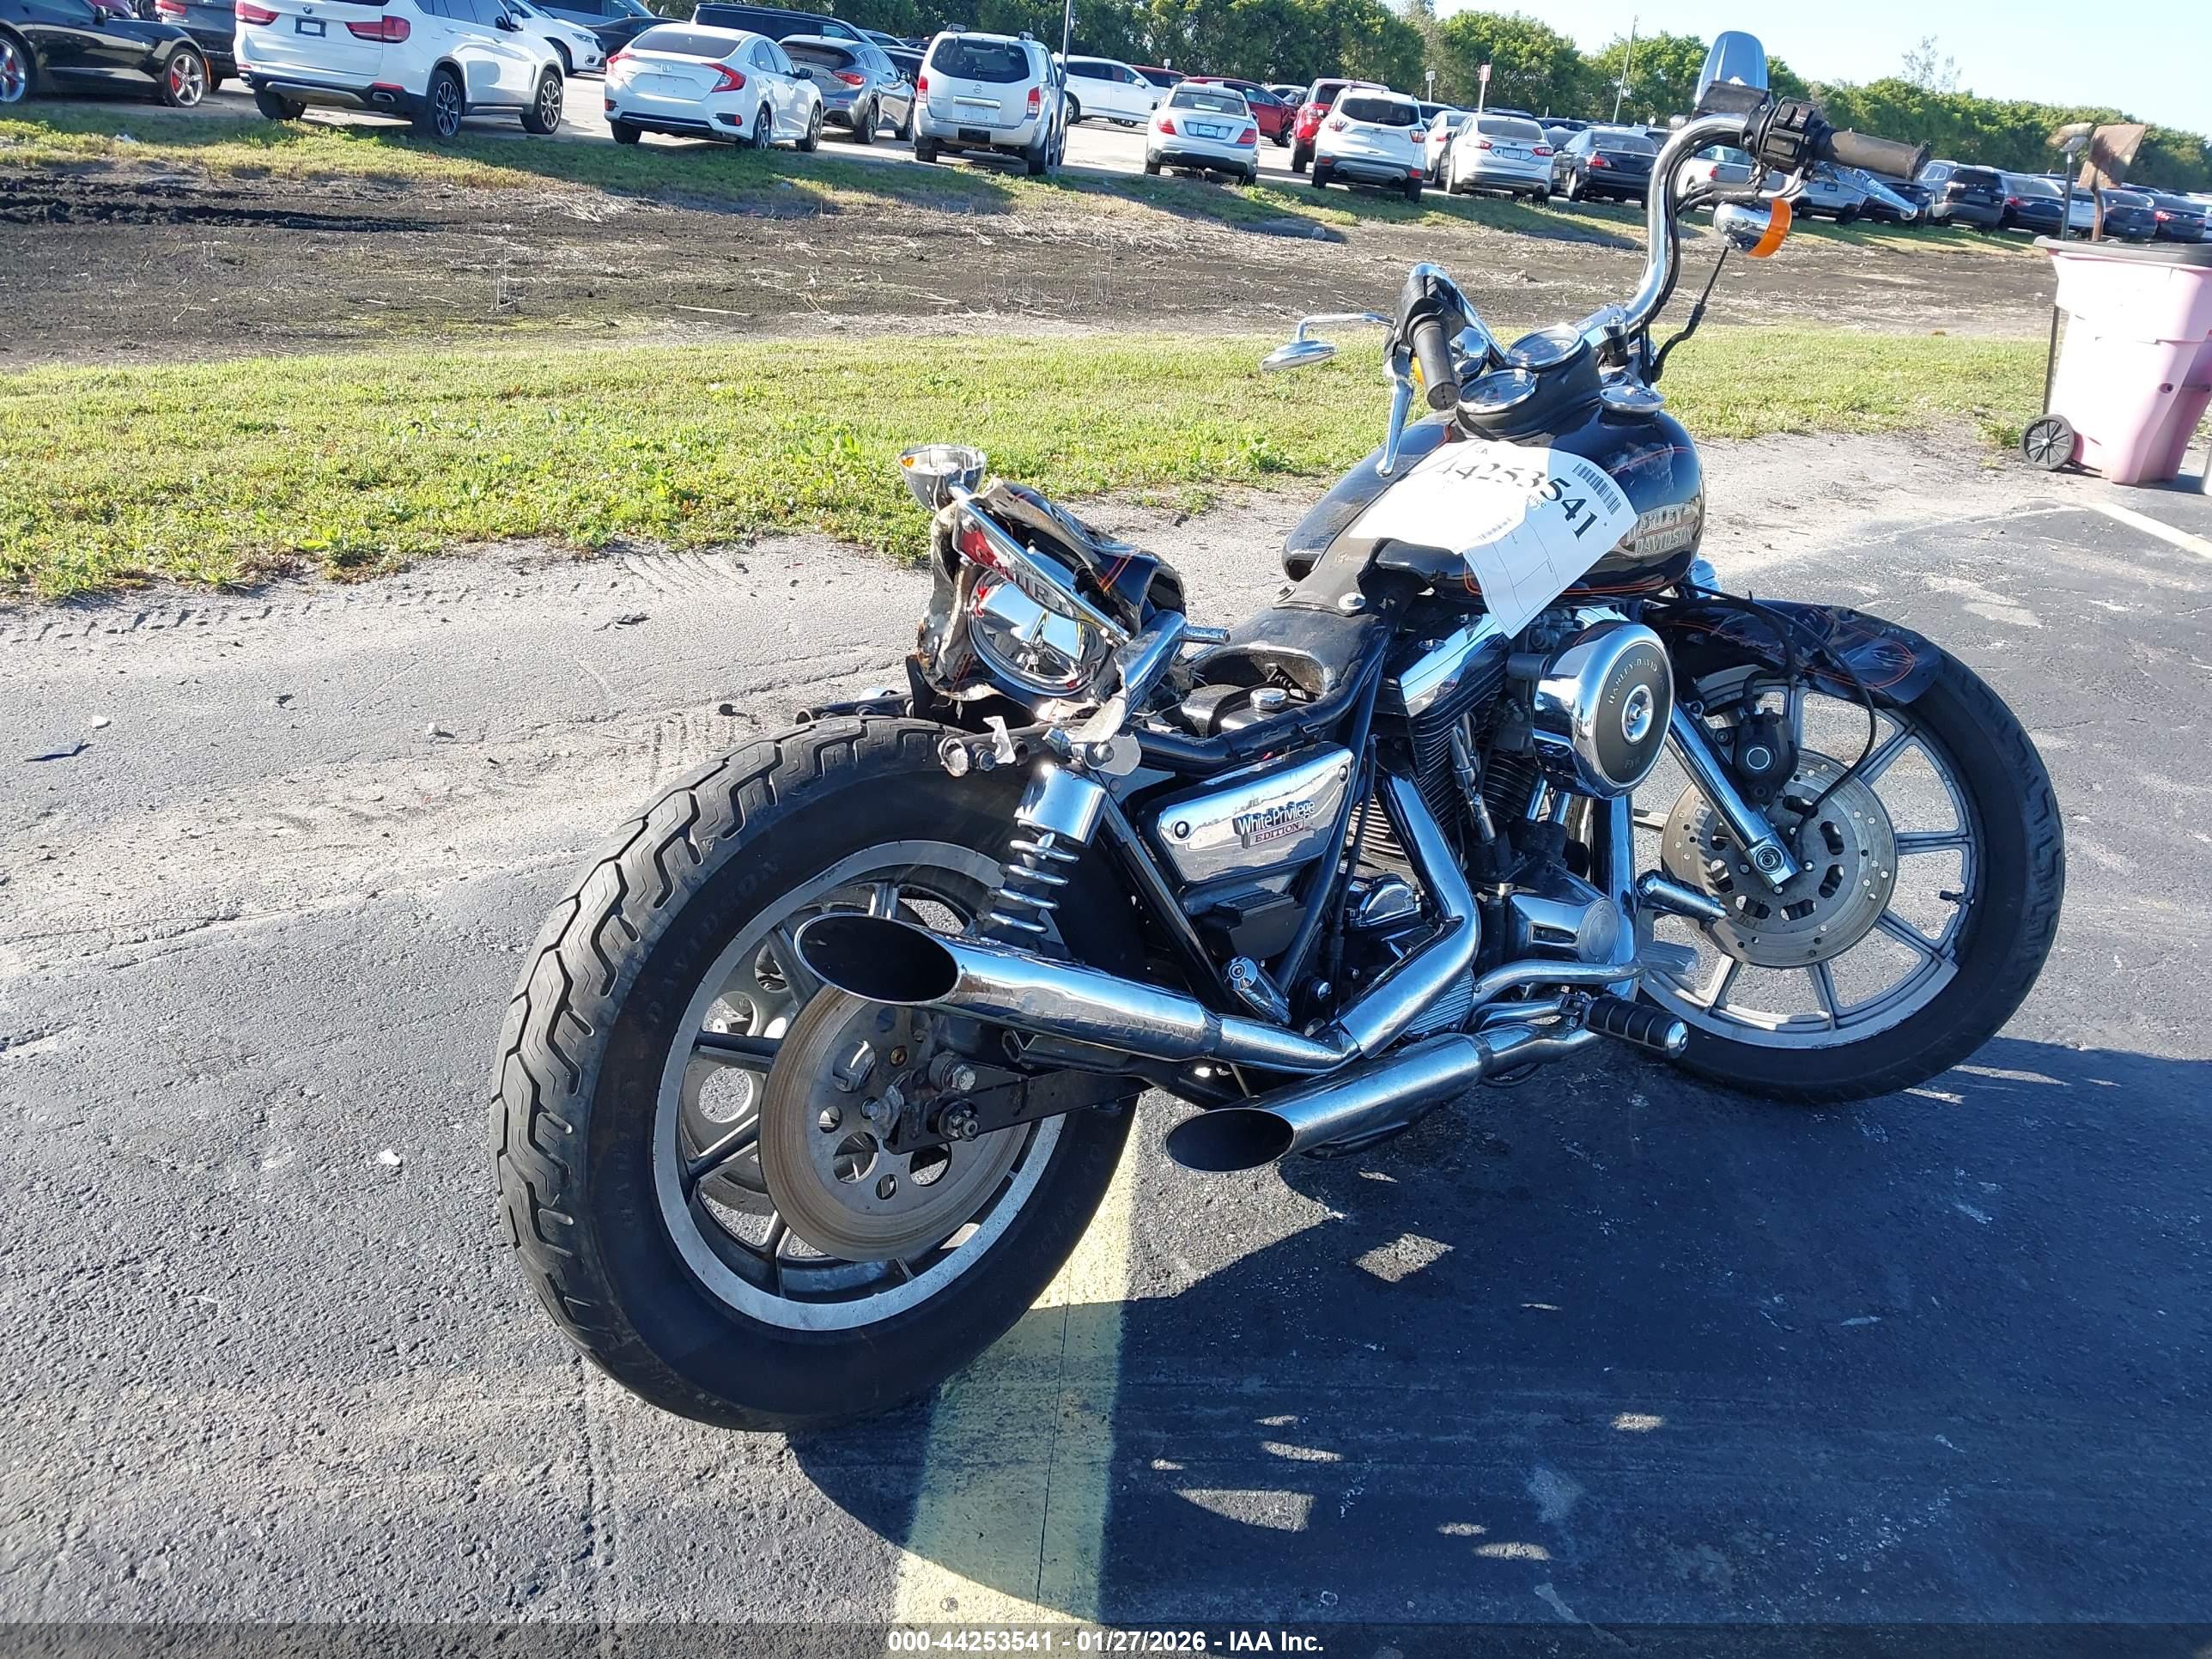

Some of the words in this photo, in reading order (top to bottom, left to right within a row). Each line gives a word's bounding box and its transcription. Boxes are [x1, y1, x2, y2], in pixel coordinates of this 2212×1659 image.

[1237, 812, 1272, 836] White
[1273, 801, 1316, 825] Privilege
[1255, 822, 1300, 843] EDITION
